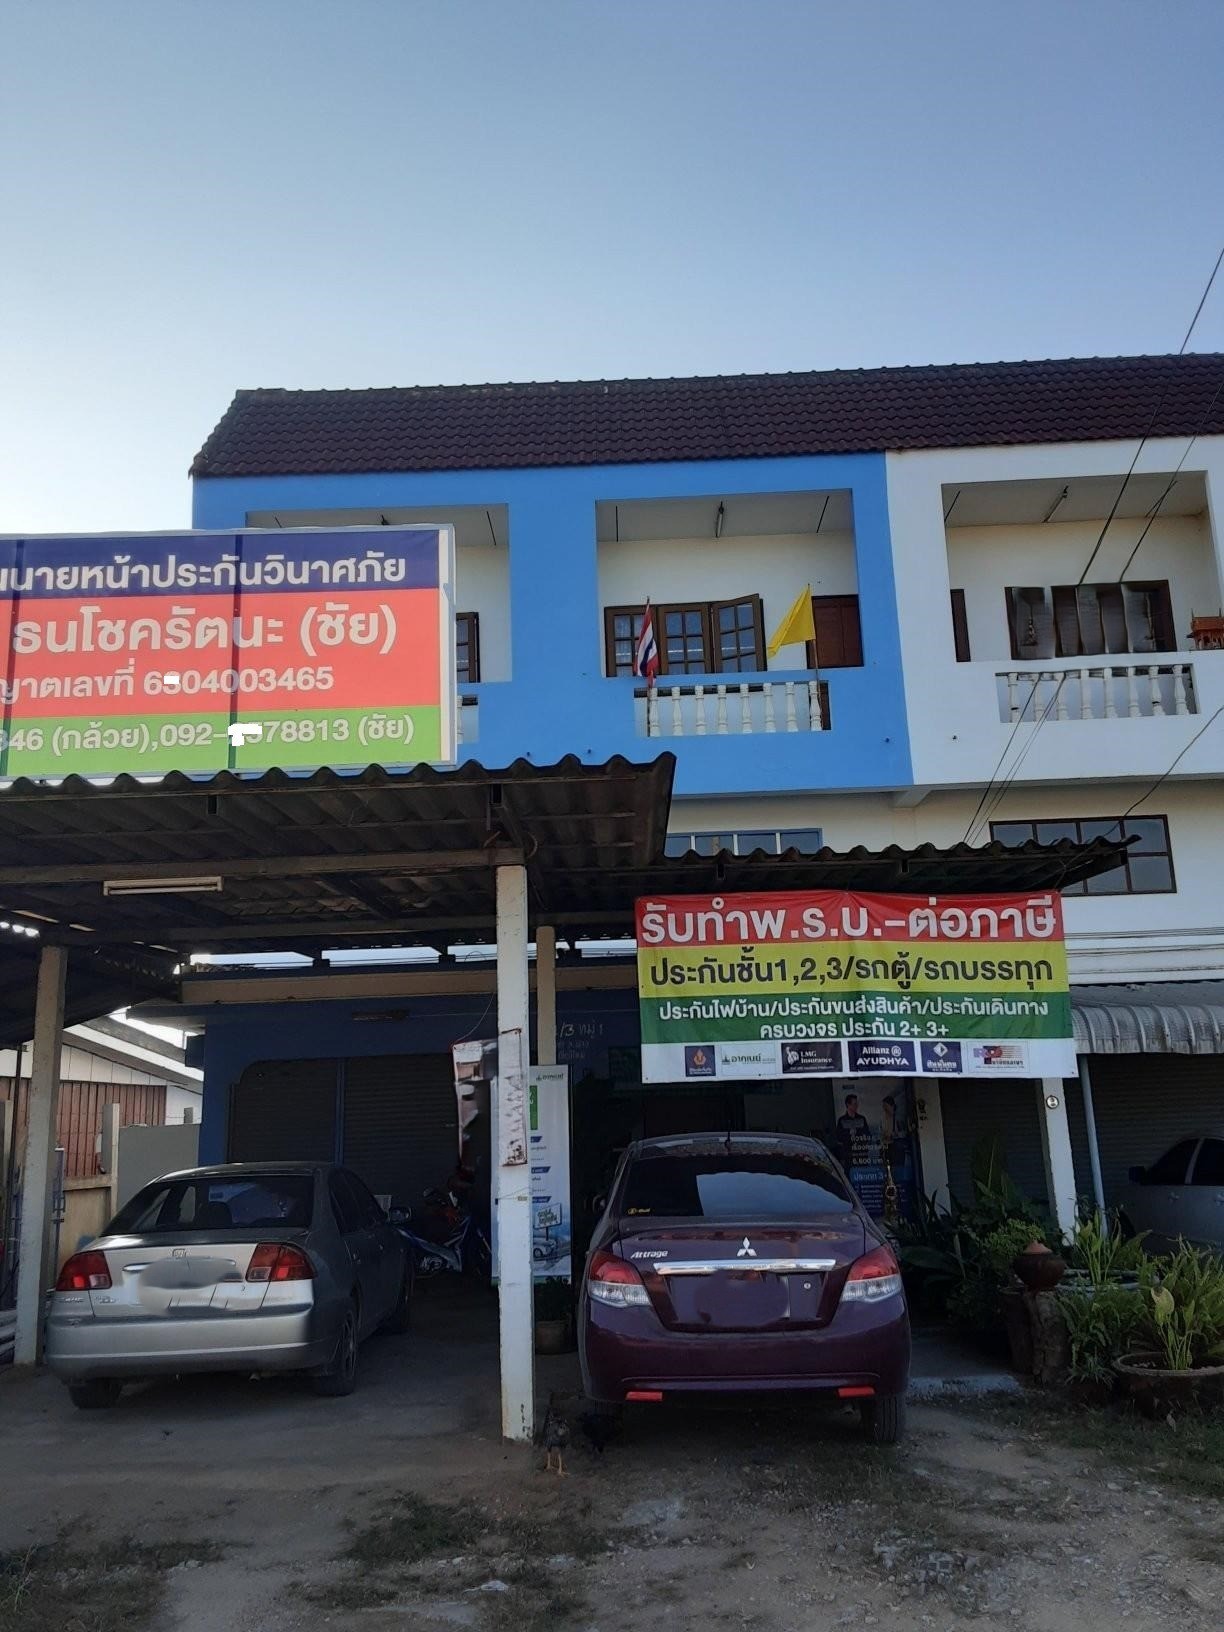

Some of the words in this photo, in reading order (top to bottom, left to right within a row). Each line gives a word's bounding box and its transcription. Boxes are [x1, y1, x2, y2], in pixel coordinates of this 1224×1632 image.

[13, 605, 284, 654] ธนโชครัตนะ
[300, 602, 397, 656] (ชัย)
[358, 714, 414, 746] (ชัย)
[659, 996, 1048, 1020] ประกันไฟบ้าน/ประกันขนส่งสินค้า/ประกันเดินทาง
[760, 1023, 837, 1039] ครบวงจร
[842, 1018, 895, 1037] ประกัน
[899, 1021, 921, 1037] 2+
[926, 1021, 949, 1037] 3+
[801, 1050, 817, 1058] LMG
[862, 1046, 890, 1055] Allianz
[857, 1056, 910, 1066] AYUDHYA
[630, 1251, 669, 1259] Attrage
